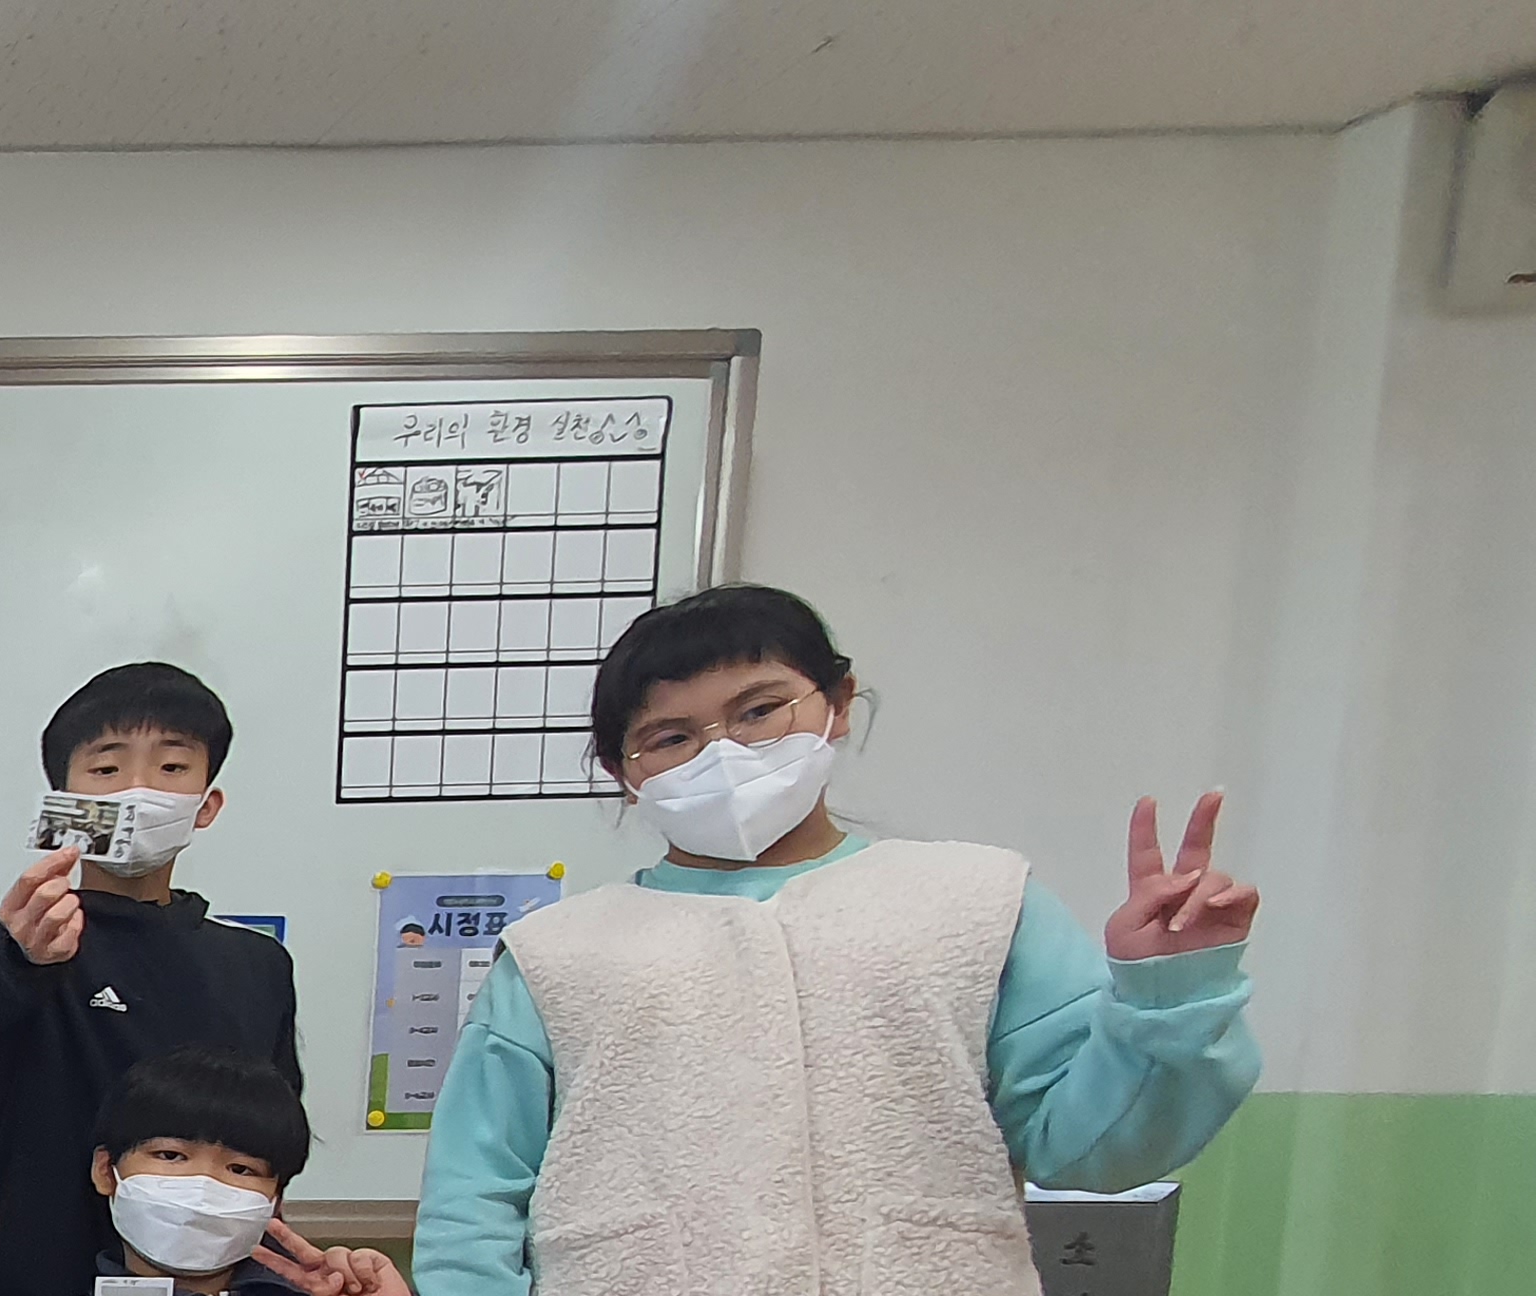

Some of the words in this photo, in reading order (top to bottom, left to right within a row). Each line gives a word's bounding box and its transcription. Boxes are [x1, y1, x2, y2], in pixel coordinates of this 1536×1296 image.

[393, 412, 469, 449] 우리의
[487, 409, 532, 444] 환경
[427, 911, 510, 938] 시정표
